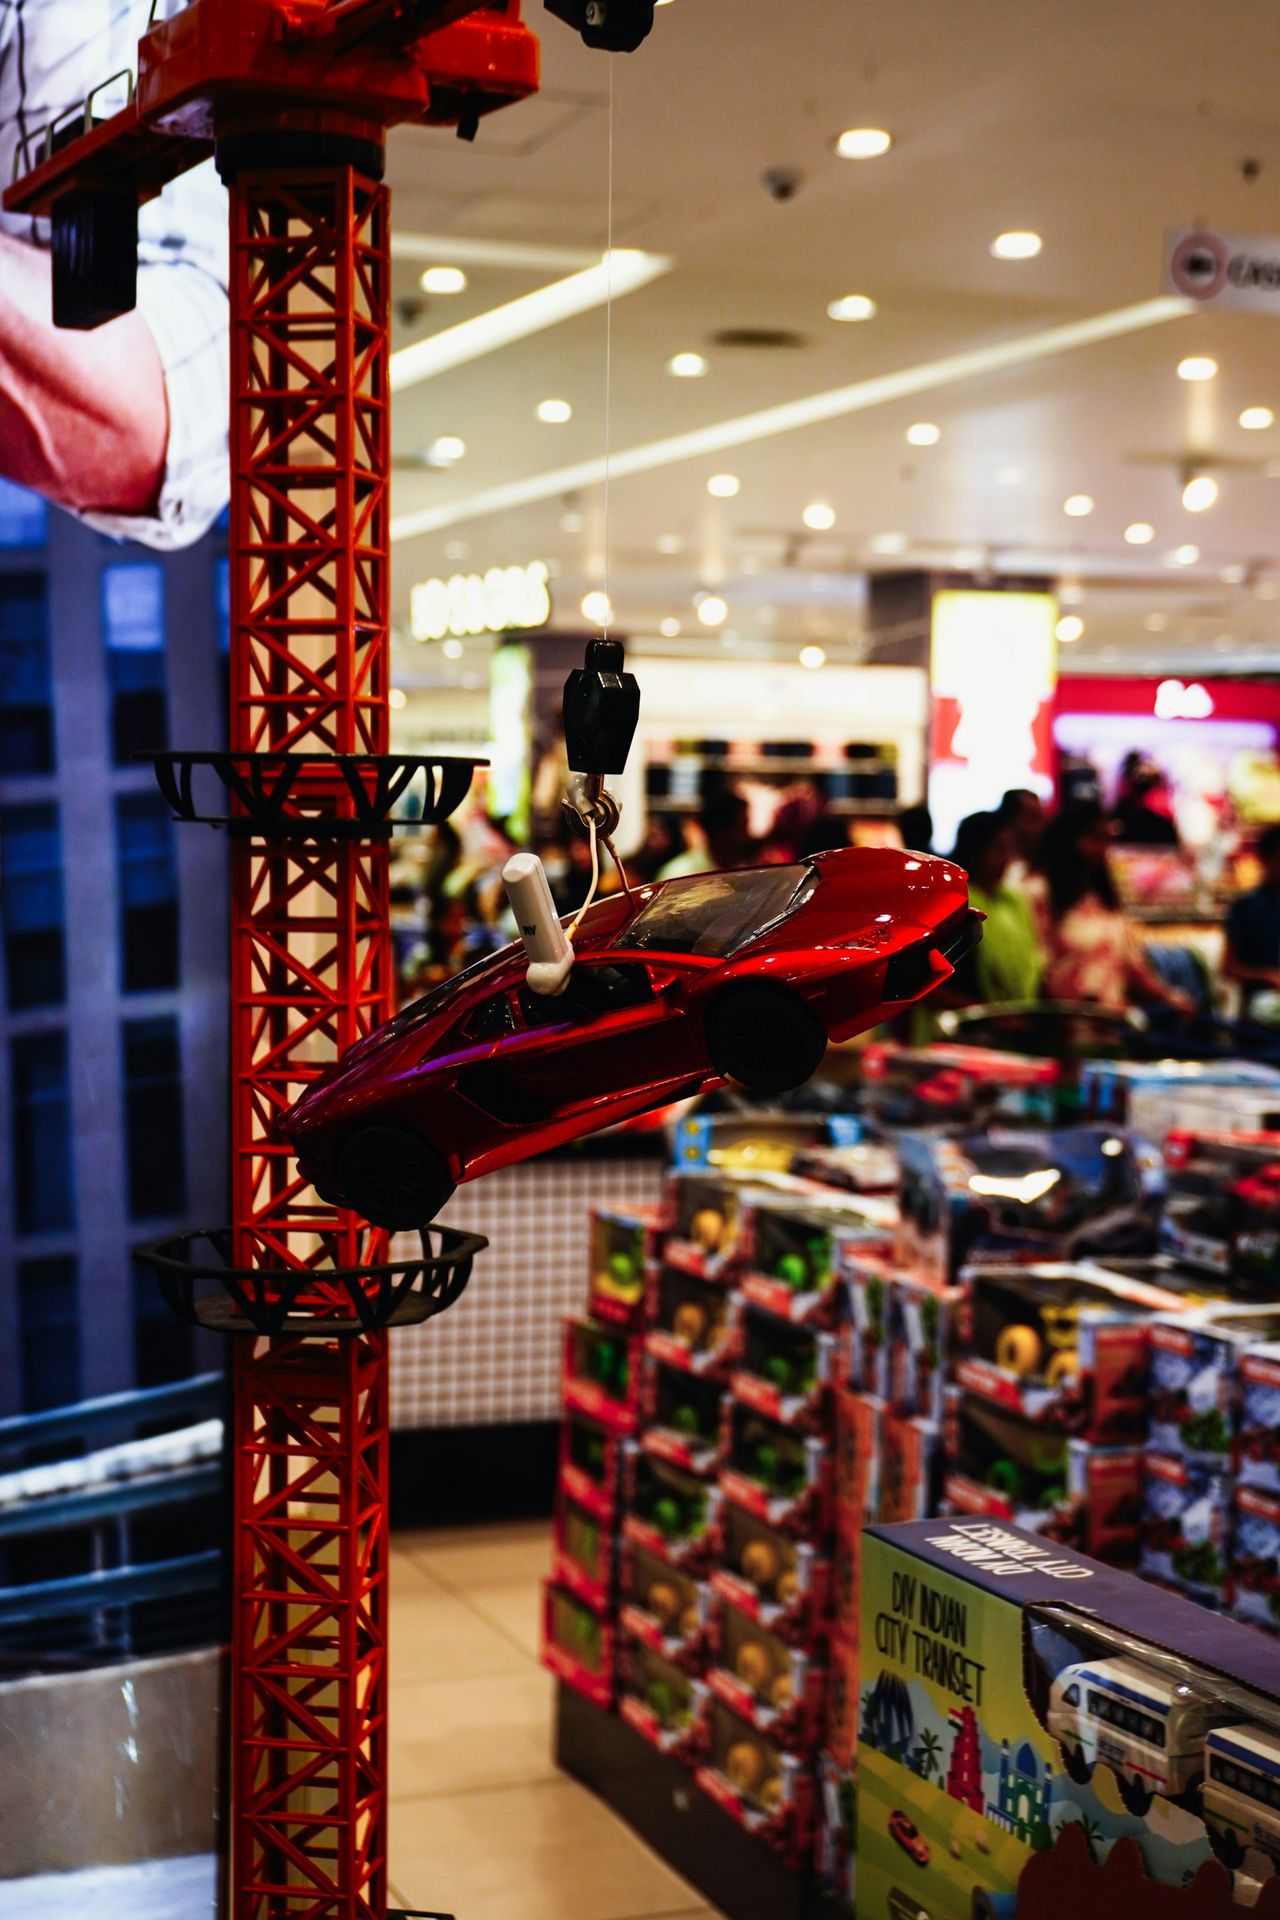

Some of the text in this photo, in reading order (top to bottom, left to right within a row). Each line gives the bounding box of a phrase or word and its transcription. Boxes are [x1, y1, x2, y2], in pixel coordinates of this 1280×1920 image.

[875, 1612, 910, 1665] CITY
[891, 1571, 967, 1648] DIY INDIAN
